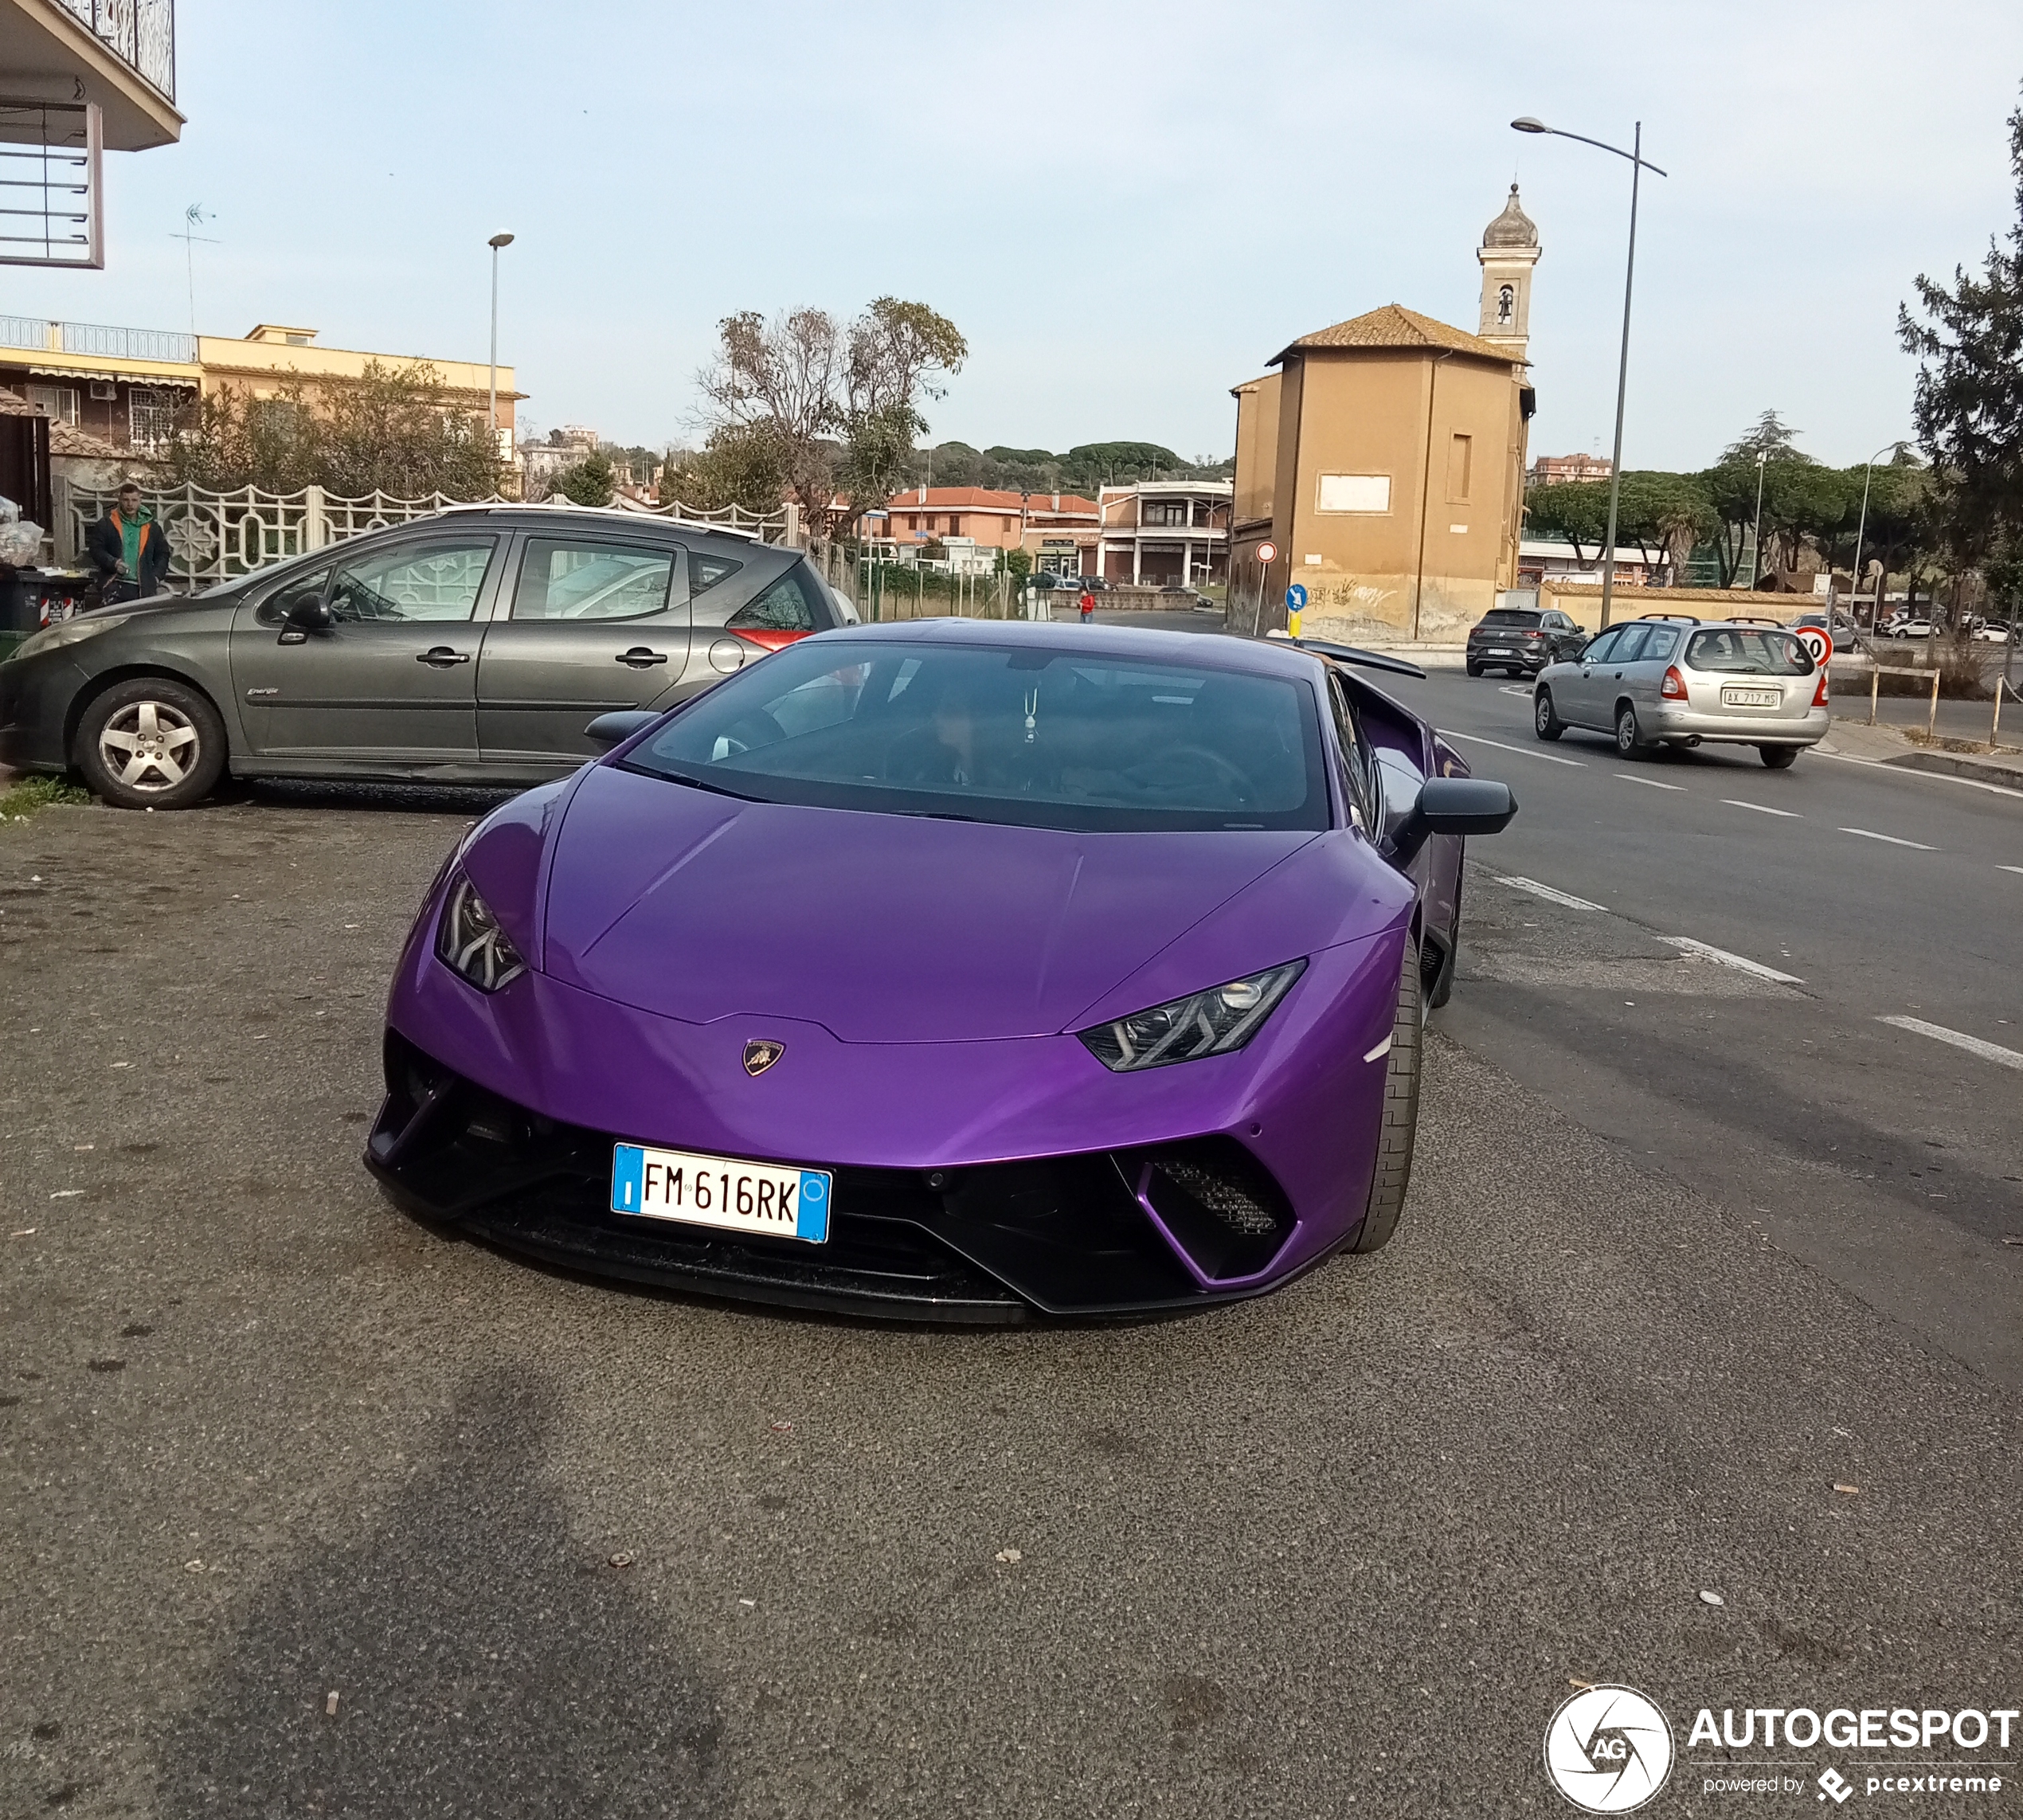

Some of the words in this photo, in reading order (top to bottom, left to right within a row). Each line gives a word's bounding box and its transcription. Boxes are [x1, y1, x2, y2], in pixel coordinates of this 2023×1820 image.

[1728, 693, 1738, 702] AX
[1744, 694, 1761, 703] 717
[1765, 695, 1775, 703] MS
[644, 1164, 683, 1205] FM
[695, 1171, 796, 1222] 616RK
